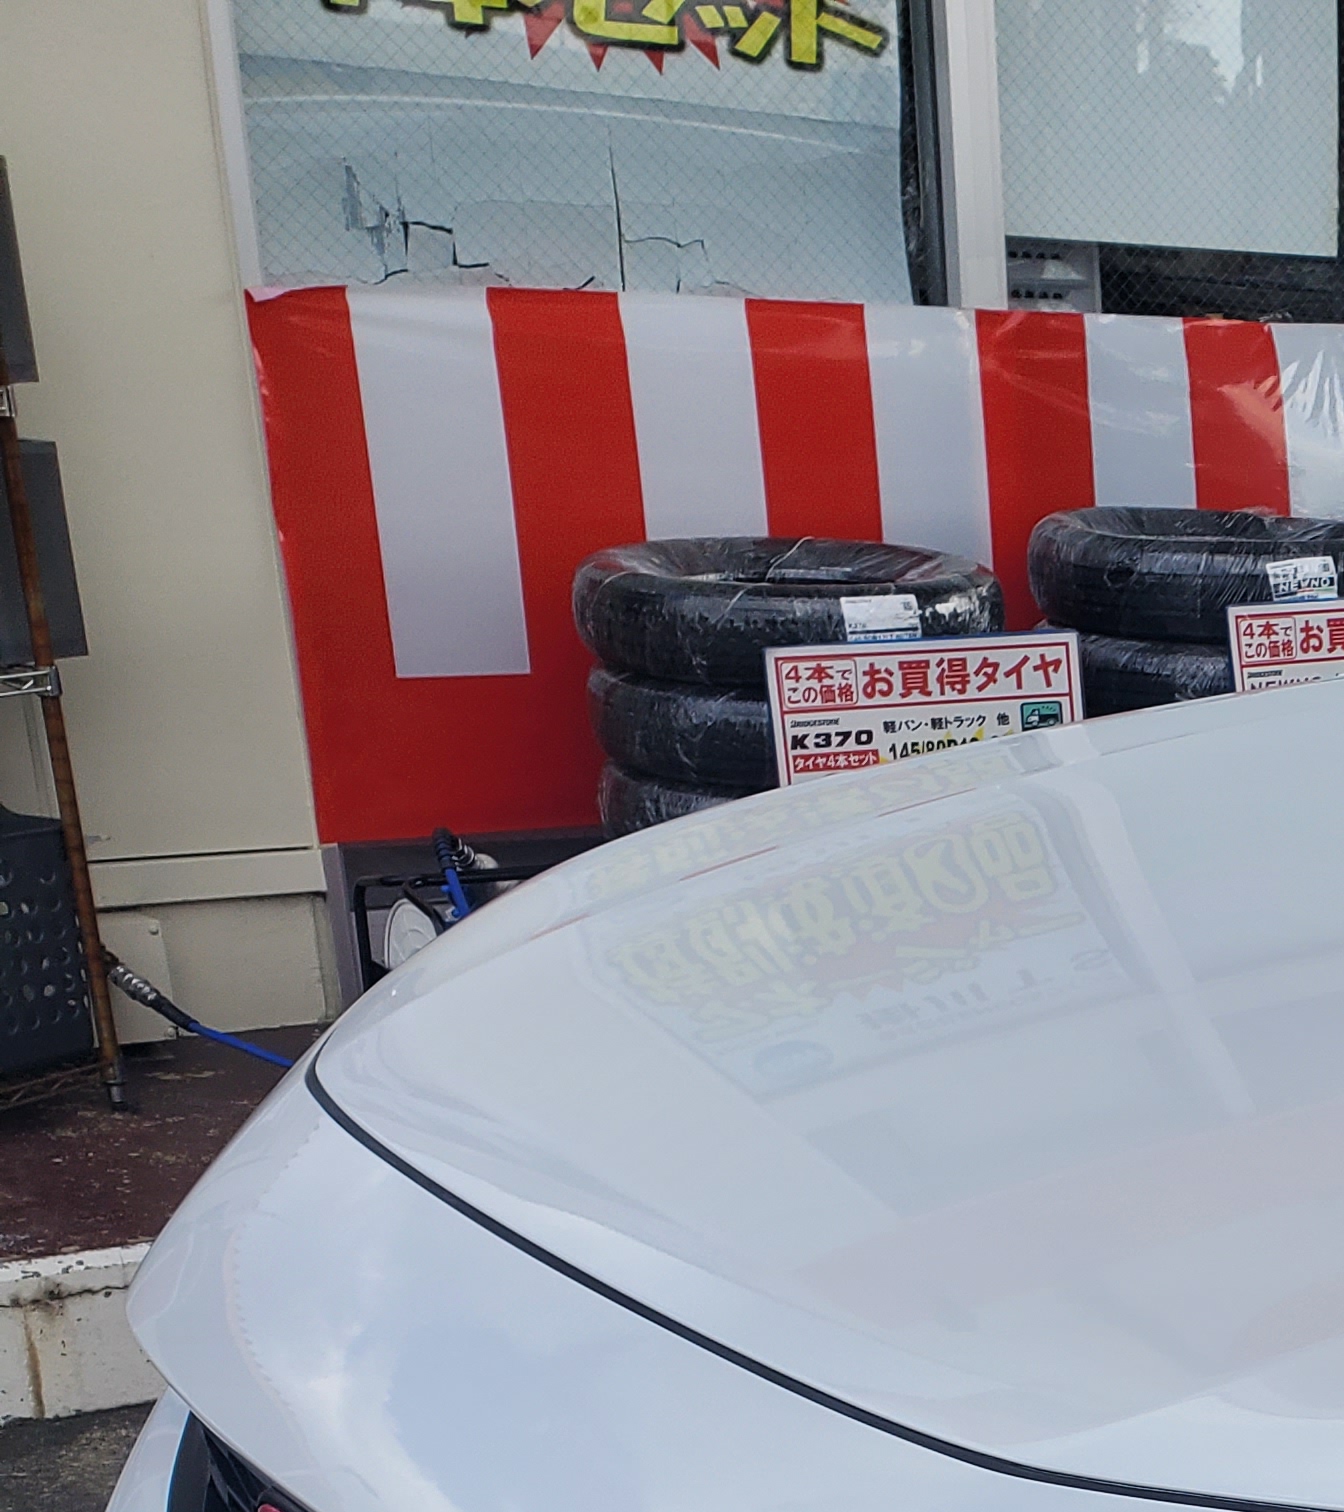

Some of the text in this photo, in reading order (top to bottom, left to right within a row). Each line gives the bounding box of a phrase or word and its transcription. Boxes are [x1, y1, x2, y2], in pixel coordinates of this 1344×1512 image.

[1242, 620, 1293, 640] 4本で
[1244, 638, 1295, 659] この価格
[784, 664, 853, 685] 4本で
[861, 653, 1064, 699] お買得タイヤ
[787, 683, 855, 705] この価格
[882, 713, 987, 735] 軽バン・軽トラック
[791, 729, 873, 750] K370
[794, 753, 878, 771] タイヤ4本セット
